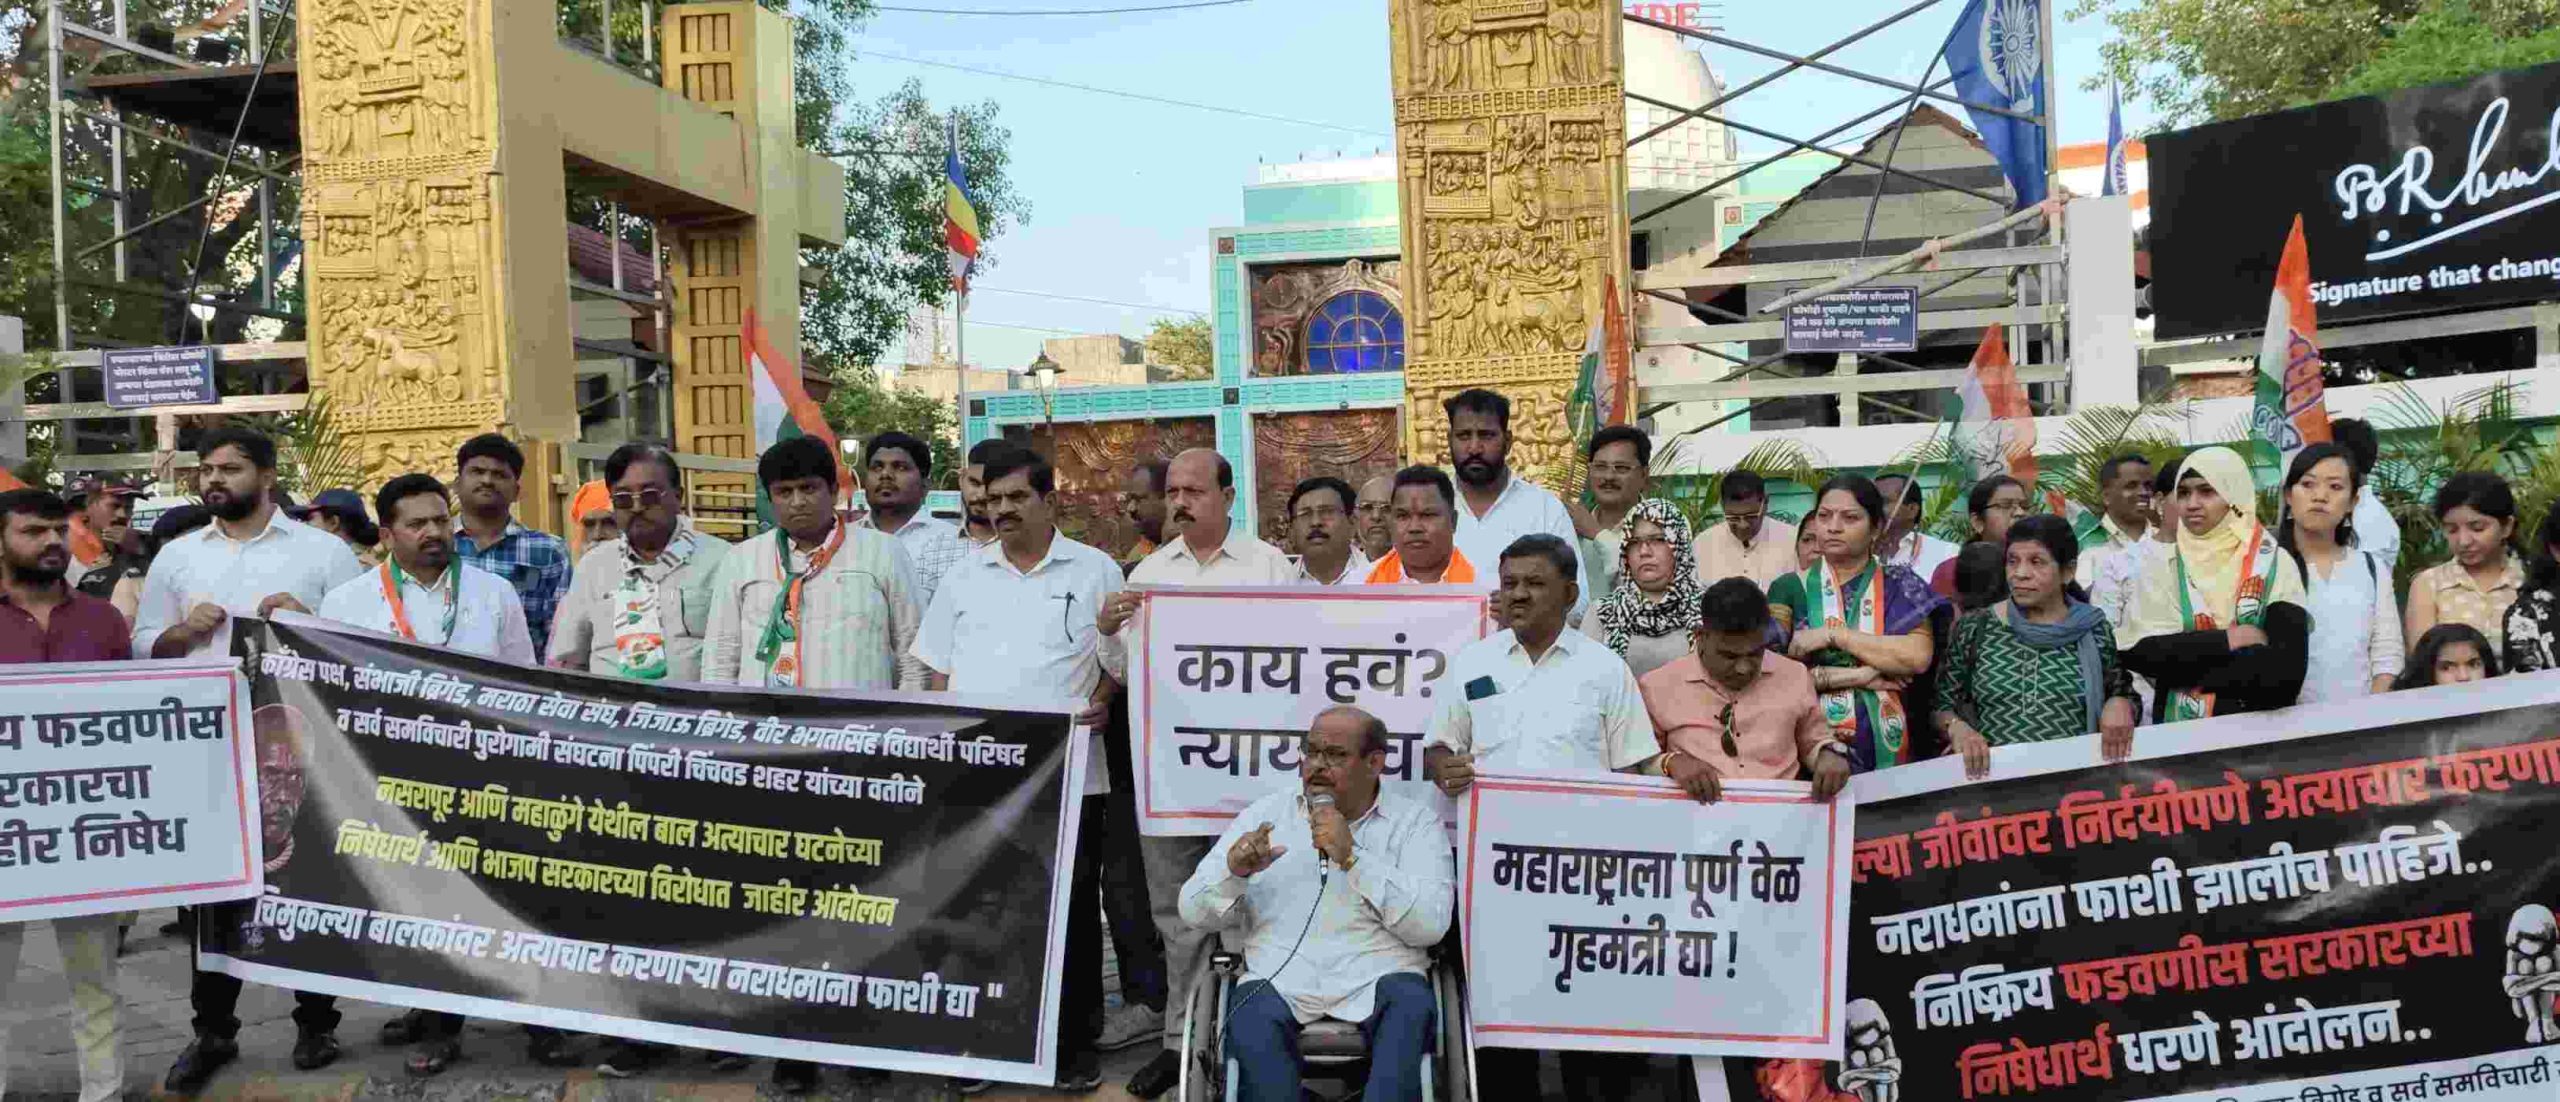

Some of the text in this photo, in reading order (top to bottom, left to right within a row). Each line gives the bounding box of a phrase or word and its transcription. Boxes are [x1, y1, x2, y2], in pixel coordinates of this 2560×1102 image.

[2307, 273, 2423, 307] Signature
[2428, 264, 2482, 288] that
[1174, 632, 1447, 703] काय हवं?
[32, 697, 226, 748] फडवणीस
[317, 661, 350, 692] पक्ष,
[353, 663, 421, 697] संभाजी
[420, 671, 474, 707] ब्रिगेड,
[476, 686, 537, 715] मराठा
[538, 691, 581, 720] सेवा
[580, 698, 620, 729] संघ,
[624, 701, 696, 735] जिजाऊ
[694, 709, 749, 743] ब्रिगेड,
[753, 716, 792, 745] वीर
[790, 724, 883, 756] भगतसिंह
[882, 727, 955, 762] विद्यार्थी
[958, 736, 1028, 767] परिषद
[337, 707, 926, 805] व सर्व समविचारी पुरोगामी संघटना पिंपरी चिंचवड शहर यांच्या वतीने
[0, 765, 151, 808] रकारचा
[376, 775, 456, 823] नसरापूर
[459, 783, 509, 822] आणि
[588, 798, 651, 841] येथील
[653, 814, 699, 848] बाल
[701, 820, 793, 859] अत्याचार
[793, 826, 884, 867] घटनेच्या
[1852, 833, 1913, 884] ल्या
[1914, 805, 2052, 871] जीवांवर
[2055, 769, 2252, 849] निर्दयीपणे
[2260, 757, 2431, 821] अत्याचार
[0, 811, 188, 867] हीर निषेध
[334, 818, 899, 927] निषेधार्थ आणि भाजप सरकारच्या विरोधात जाहीर आंदोलन
[1492, 839, 1805, 918] महाराष्ट्राला पूर्ण वेळ
[1870, 880, 2067, 955] नराधमांना
[2071, 857, 2182, 922] फाशी
[2186, 841, 2330, 914] झालीच
[254, 883, 368, 941] चिमुकल्या
[368, 912, 497, 958] बालकांवर
[495, 930, 611, 974] अत्याचार
[726, 959, 863, 1007] नराधमांना
[865, 971, 943, 1015] फाशी
[944, 982, 980, 1018] द्या
[1548, 913, 1670, 993] गृहमंत्री
[1675, 930, 1718, 978] द्या
[1909, 912, 2473, 1030] निष्क्रिय फडवणीस सरकारच्या
[1955, 1022, 2113, 1100] निषेधार्थ
[2115, 1010, 2220, 1074] धरणे
[2387, 1072, 2430, 1102] सर्व
[2432, 1055, 2550, 1097] समविचारी
